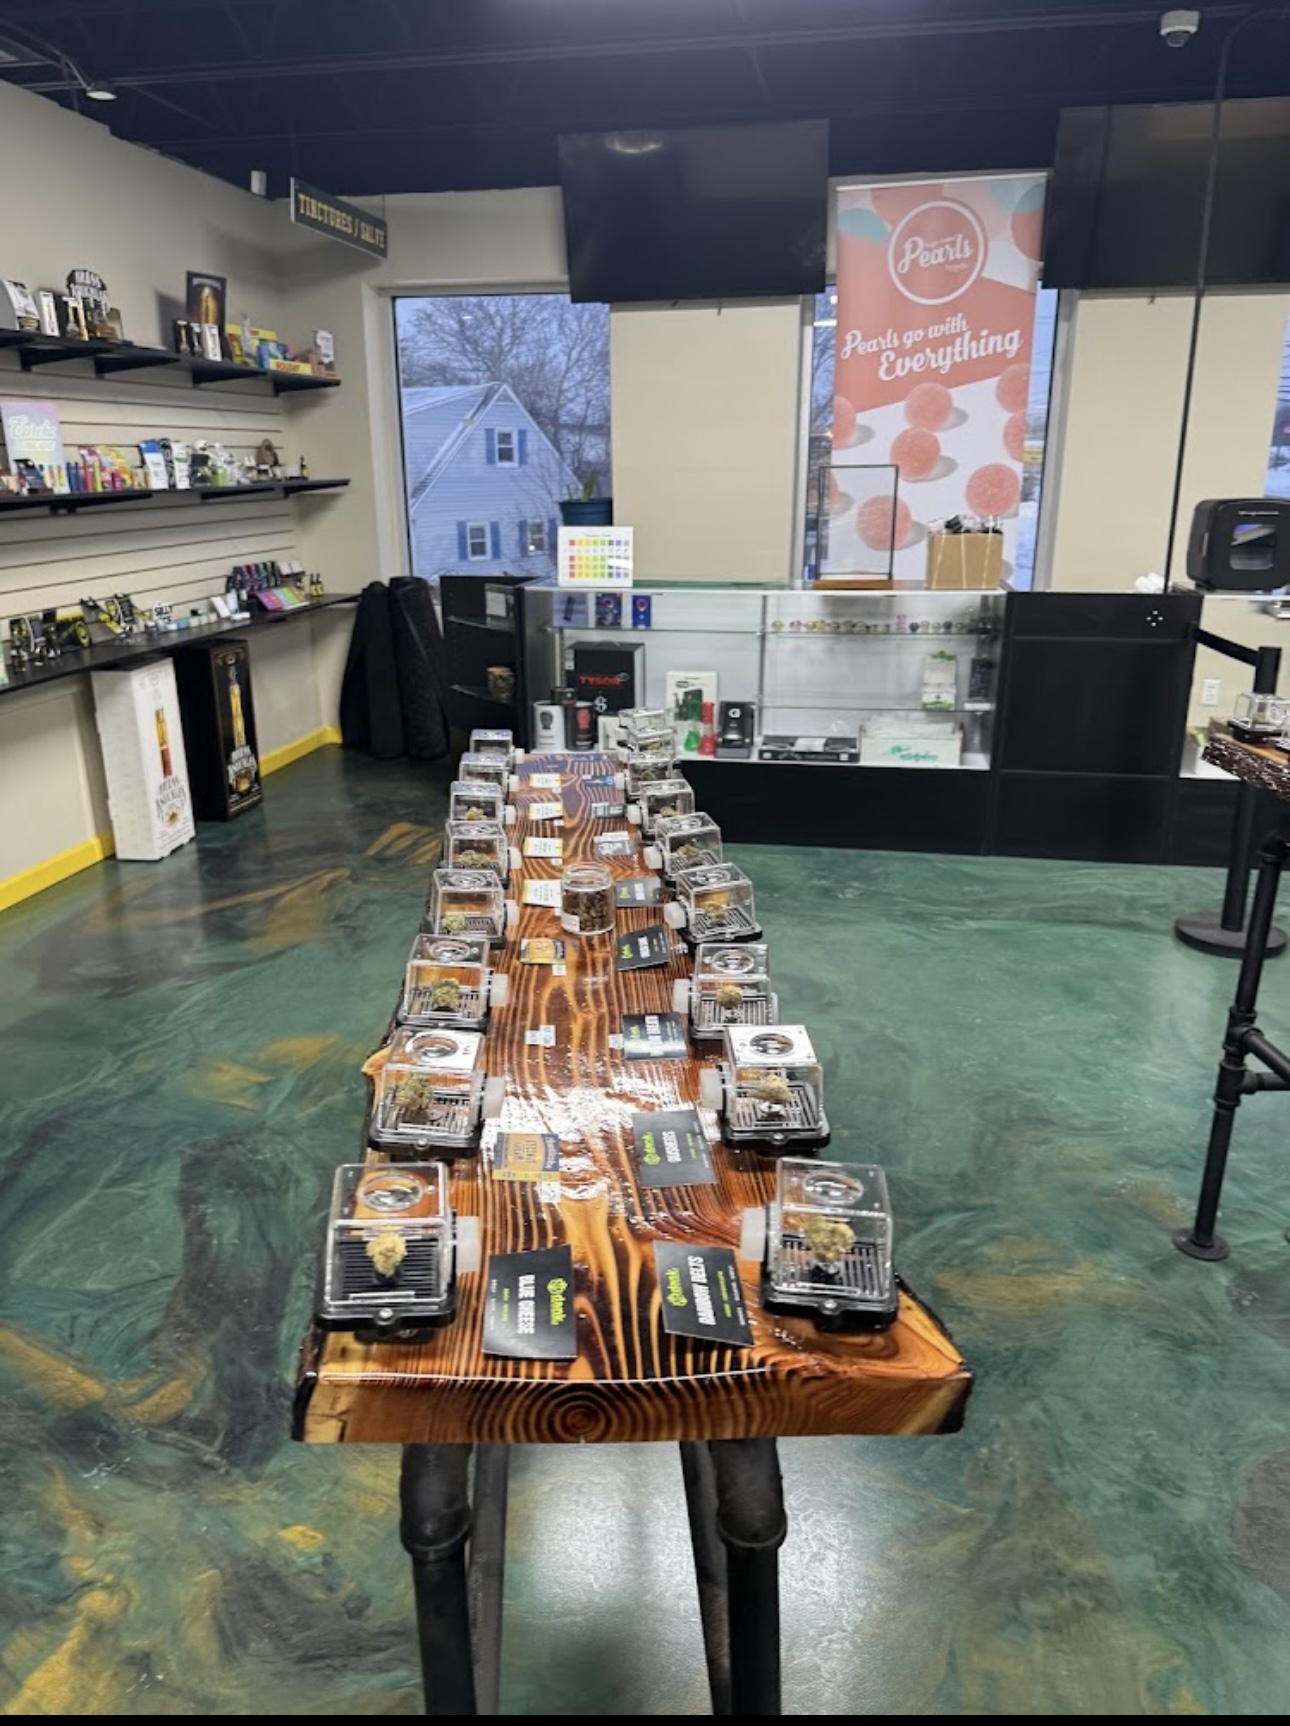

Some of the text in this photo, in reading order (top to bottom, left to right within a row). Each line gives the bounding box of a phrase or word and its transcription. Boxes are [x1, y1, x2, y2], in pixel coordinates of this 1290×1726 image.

[298, 192, 353, 234] TINCTURES
[360, 221, 385, 249] SALVE
[898, 233, 973, 273] Pearls
[841, 312, 968, 359] Pearls go with
[878, 329, 1024, 381] Everything
[517, 1274, 535, 1334] BLUE CHEESE
[688, 1255, 716, 1326] RAINBOW BELTS
